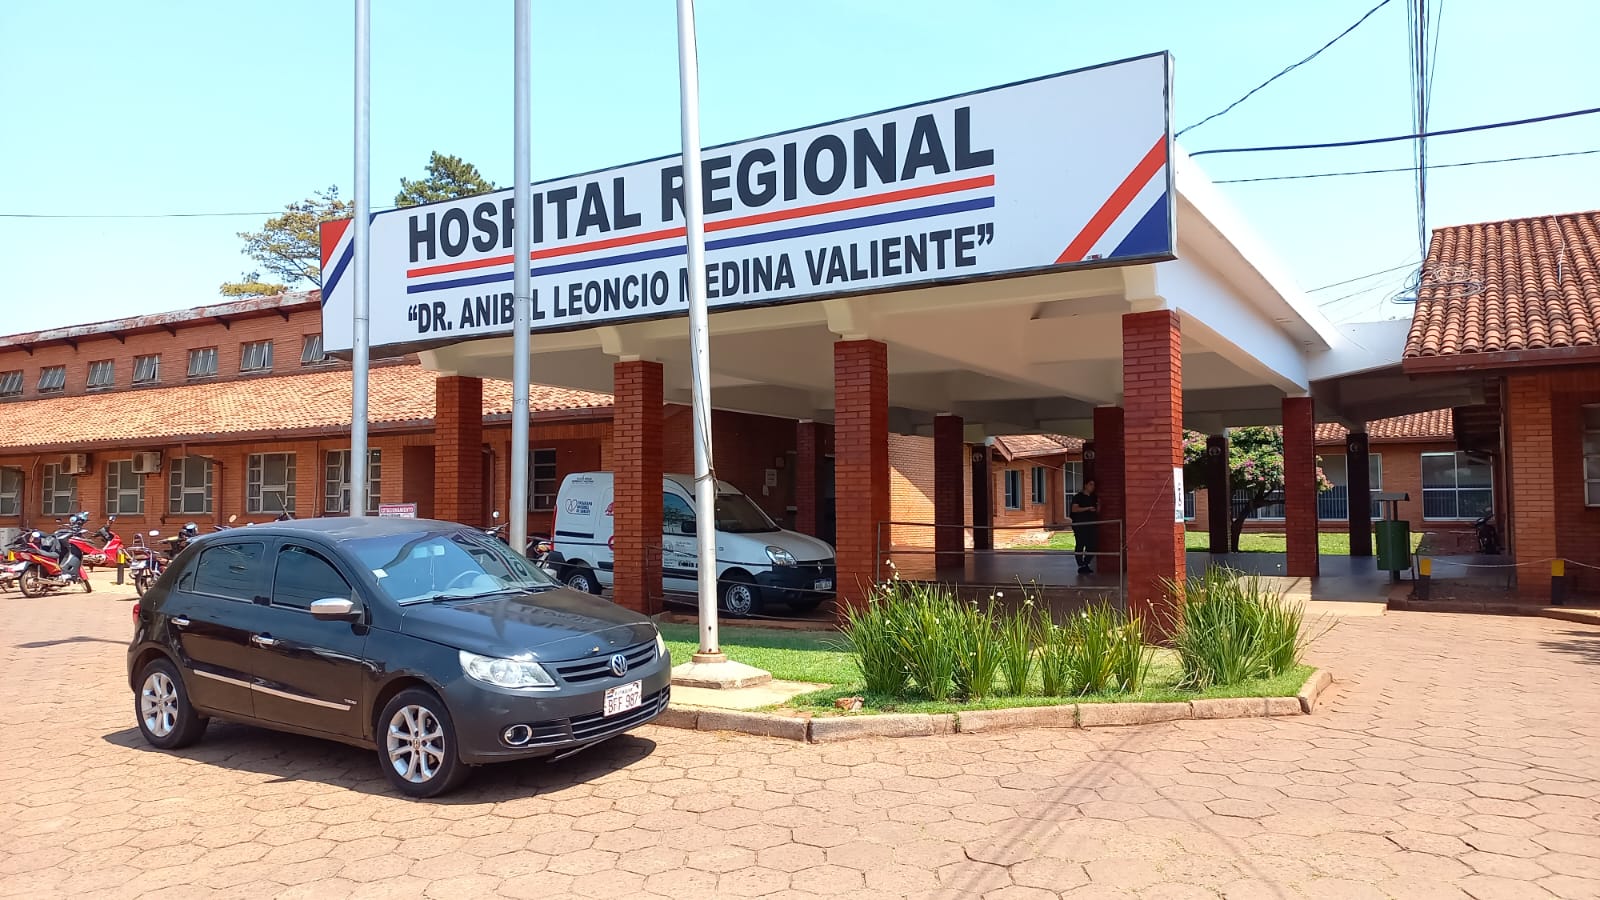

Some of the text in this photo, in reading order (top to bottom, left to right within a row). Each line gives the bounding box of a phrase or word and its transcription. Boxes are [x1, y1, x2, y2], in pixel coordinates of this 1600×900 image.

[661, 107, 994, 229] REGIONAL
[459, 289, 546, 330] ANIBL
[553, 270, 669, 317] LEONCIO
[608, 696, 623, 713] BFF
